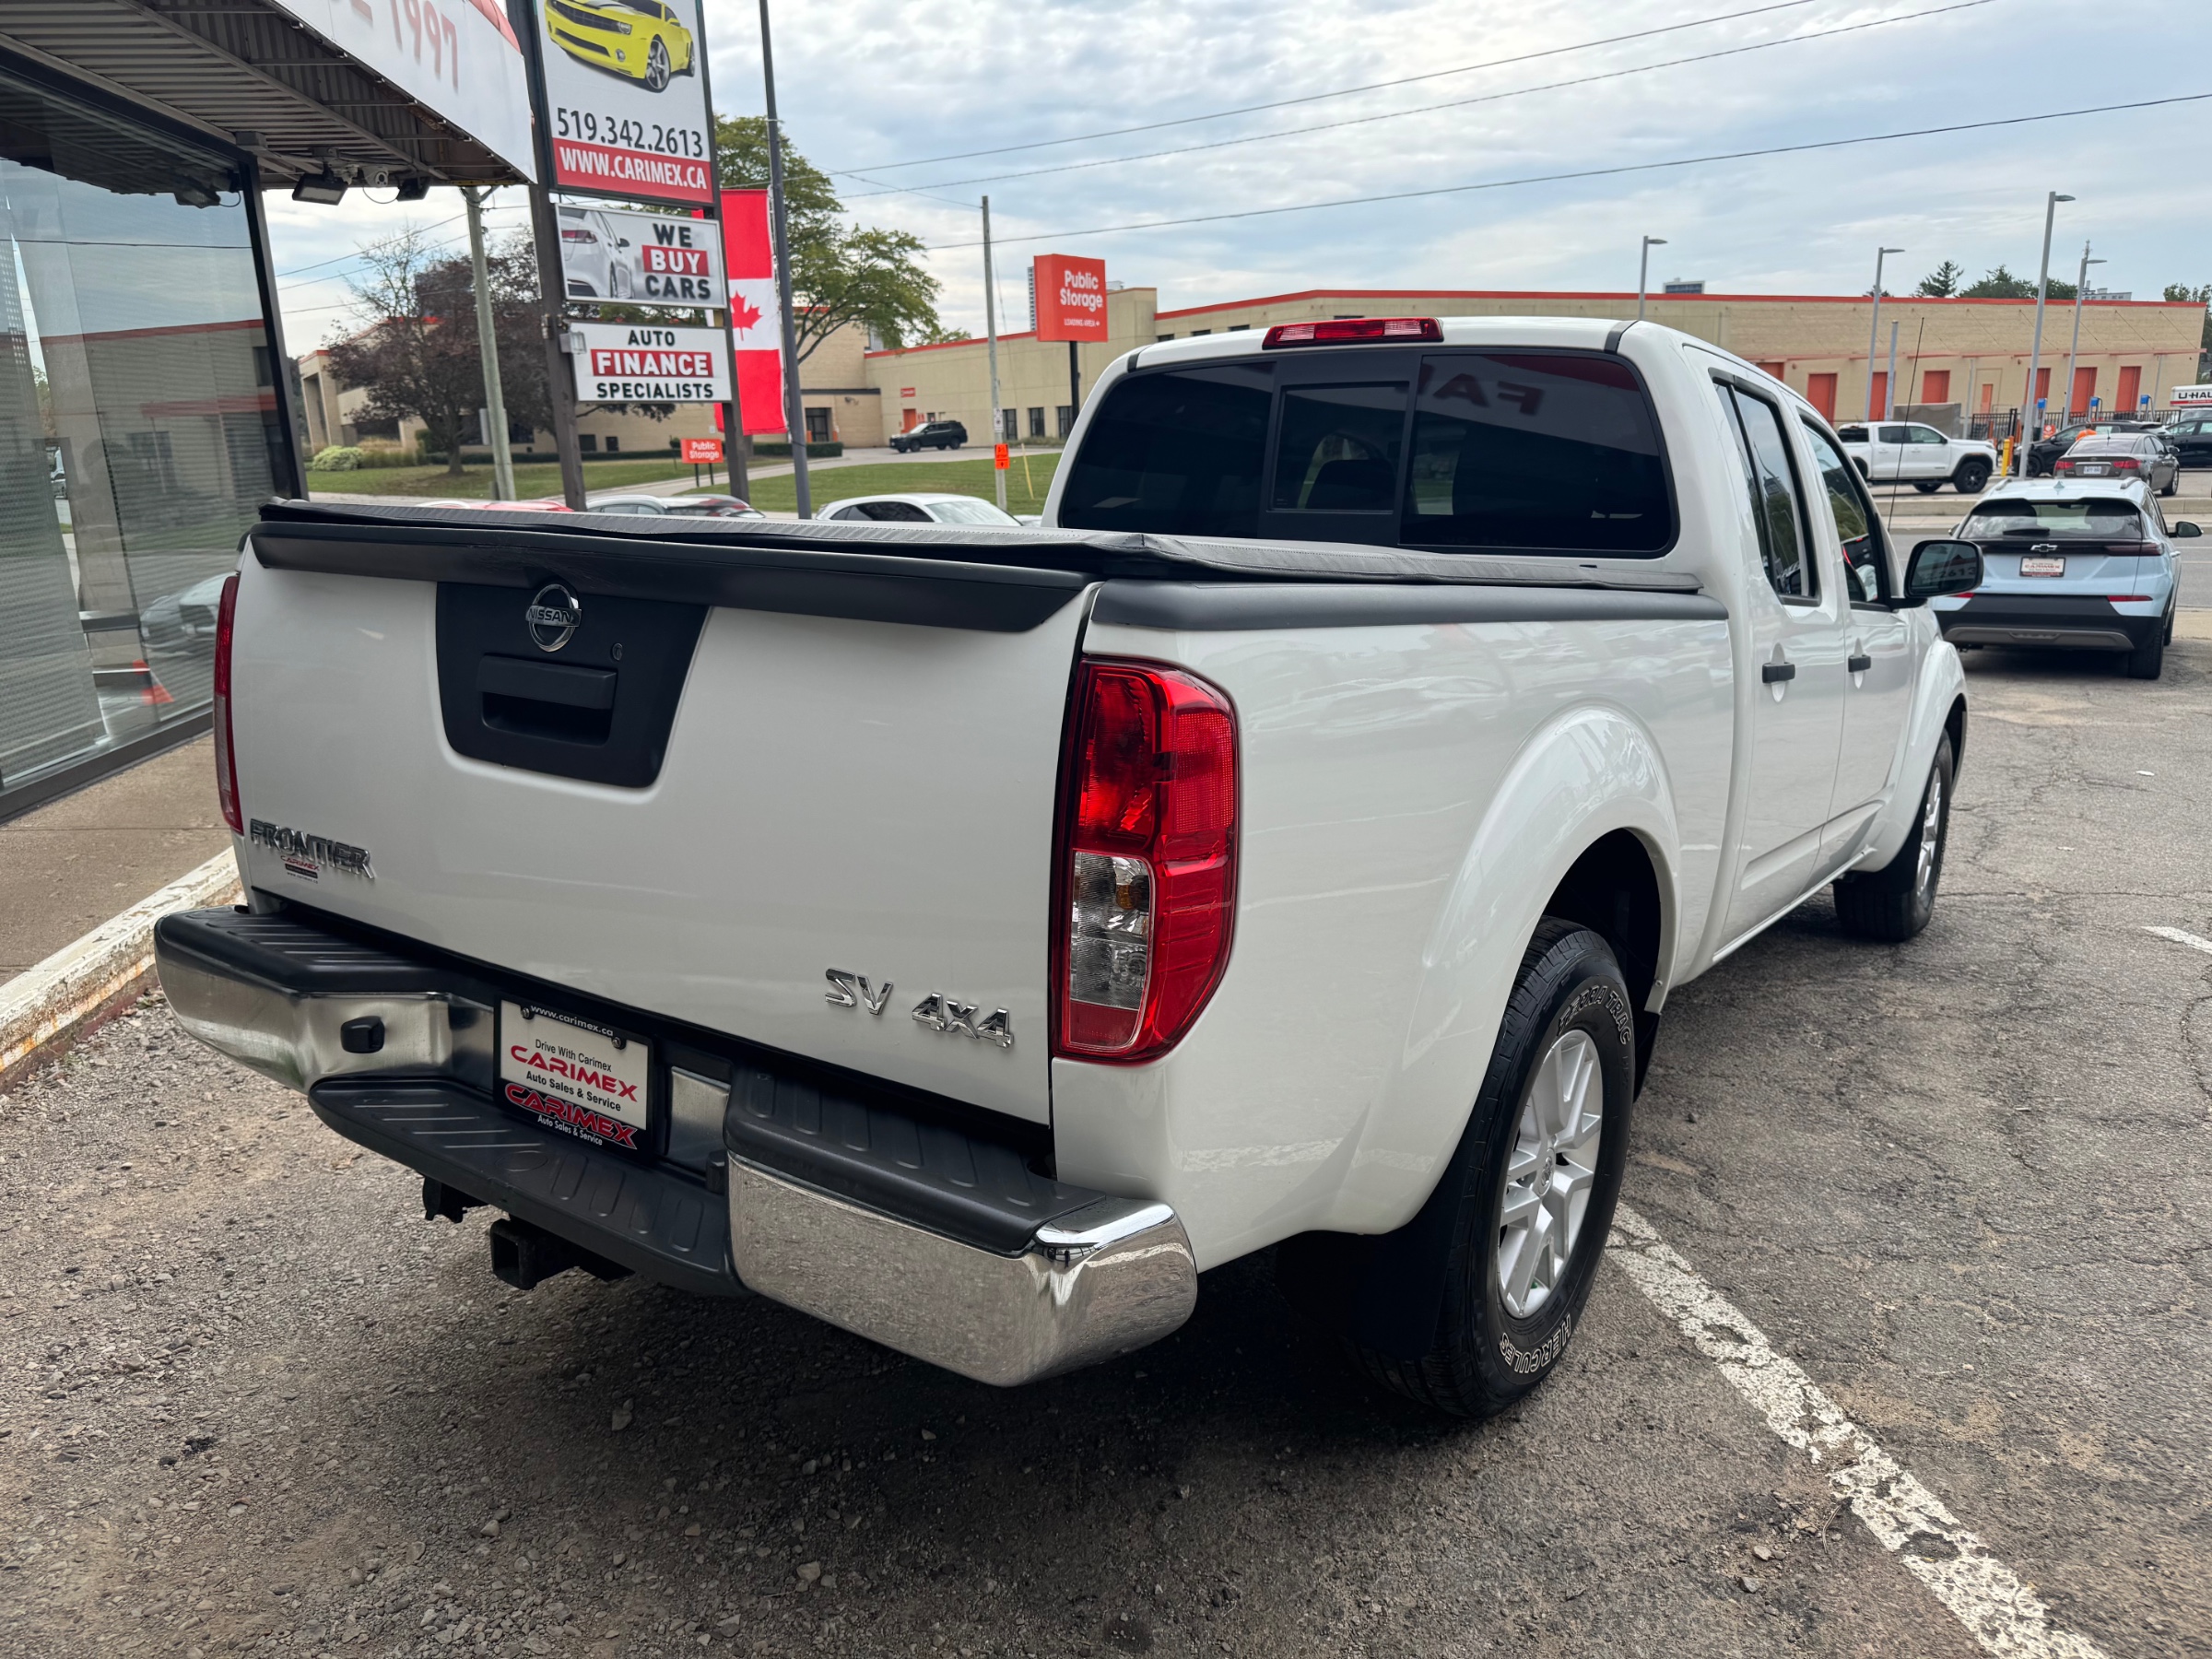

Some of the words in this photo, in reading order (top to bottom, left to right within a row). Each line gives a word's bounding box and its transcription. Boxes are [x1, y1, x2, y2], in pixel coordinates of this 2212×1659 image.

[558, 107, 703, 158] 519.342.2613
[559, 147, 708, 190] WWW.CARIMEX.CA
[653, 223, 693, 247] WE
[650, 249, 700, 274] BUY
[645, 275, 711, 300] CARS
[1064, 269, 1099, 290] Public
[1059, 288, 1103, 312] Storage
[628, 330, 676, 347] AUTO
[595, 351, 709, 376] FINANCE
[596, 382, 713, 398] SPECIALISTS
[688, 451, 720, 461] Storage
[691, 441, 716, 451] Public
[528, 608, 572, 624] NISSAN
[249, 818, 376, 879] FRONTIER
[824, 967, 894, 1016] SV
[530, 1005, 614, 1037] www.carimex.ca
[1605, 990, 1631, 1045] TRAC
[535, 1039, 556, 1053] Drive
[558, 1045, 576, 1061] With
[578, 1053, 612, 1073] Carimex
[510, 1044, 638, 1102] CARIMEX
[526, 1070, 547, 1086] Auto
[549, 1078, 574, 1096] Sales
[576, 1088, 584, 1099] &
[586, 1091, 621, 1112] Service
[505, 1082, 638, 1150] CARIMEX
[537, 1114, 553, 1127] Auto
[555, 1122, 571, 1135] Sales
[572, 1126, 579, 1136] &
[579, 1130, 603, 1147] Service
[1499, 1312, 1571, 1374] HERCULES
